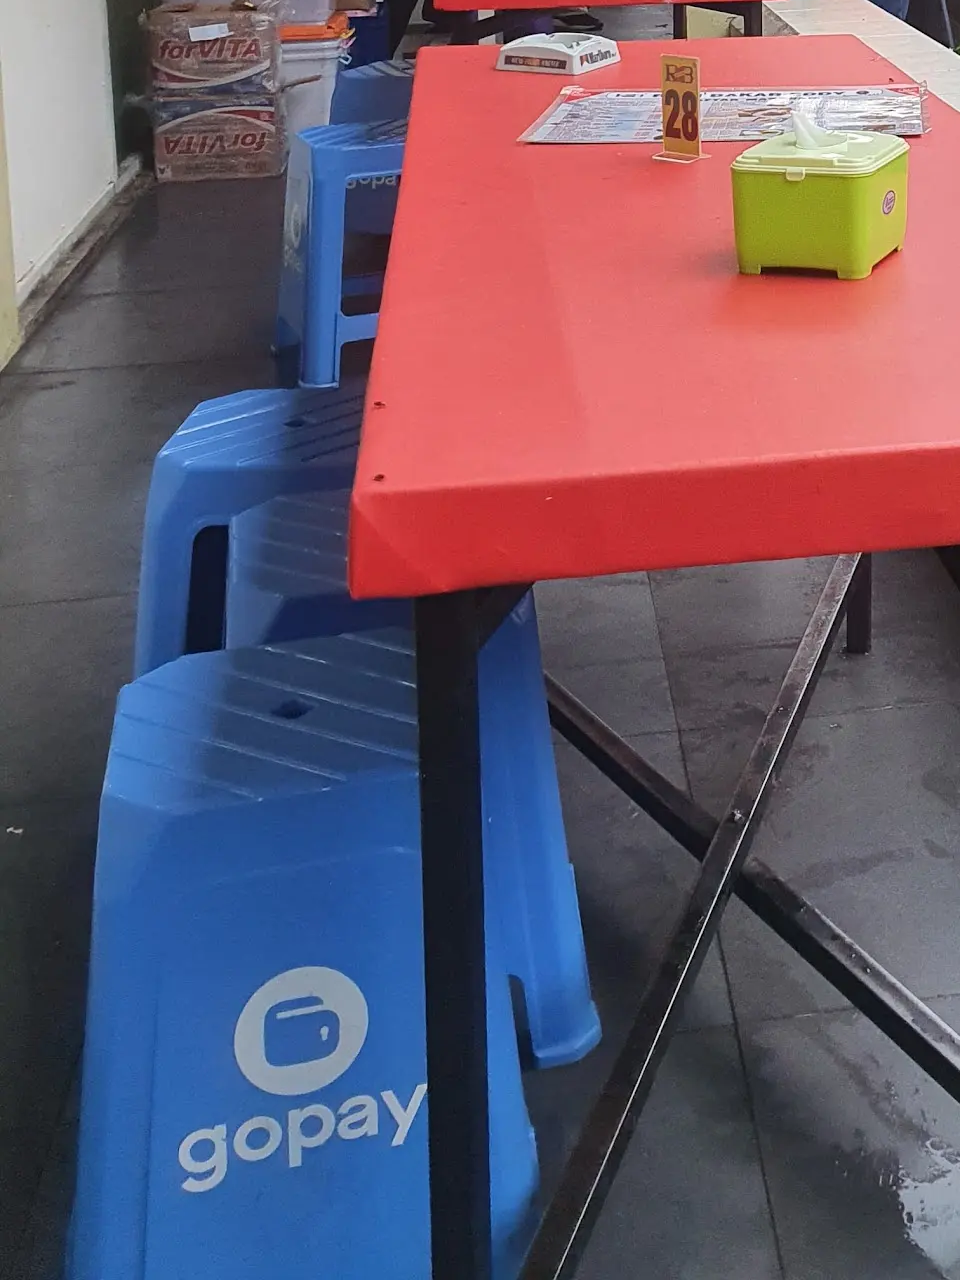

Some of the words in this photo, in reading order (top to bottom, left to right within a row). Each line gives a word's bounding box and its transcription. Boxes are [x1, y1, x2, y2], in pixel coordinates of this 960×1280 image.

[159, 37, 262, 60] forVITA
[664, 89, 699, 142] 28
[164, 131, 267, 155] forVITA
[345, 175, 398, 189] gopa
[178, 1083, 428, 1193] gopay
